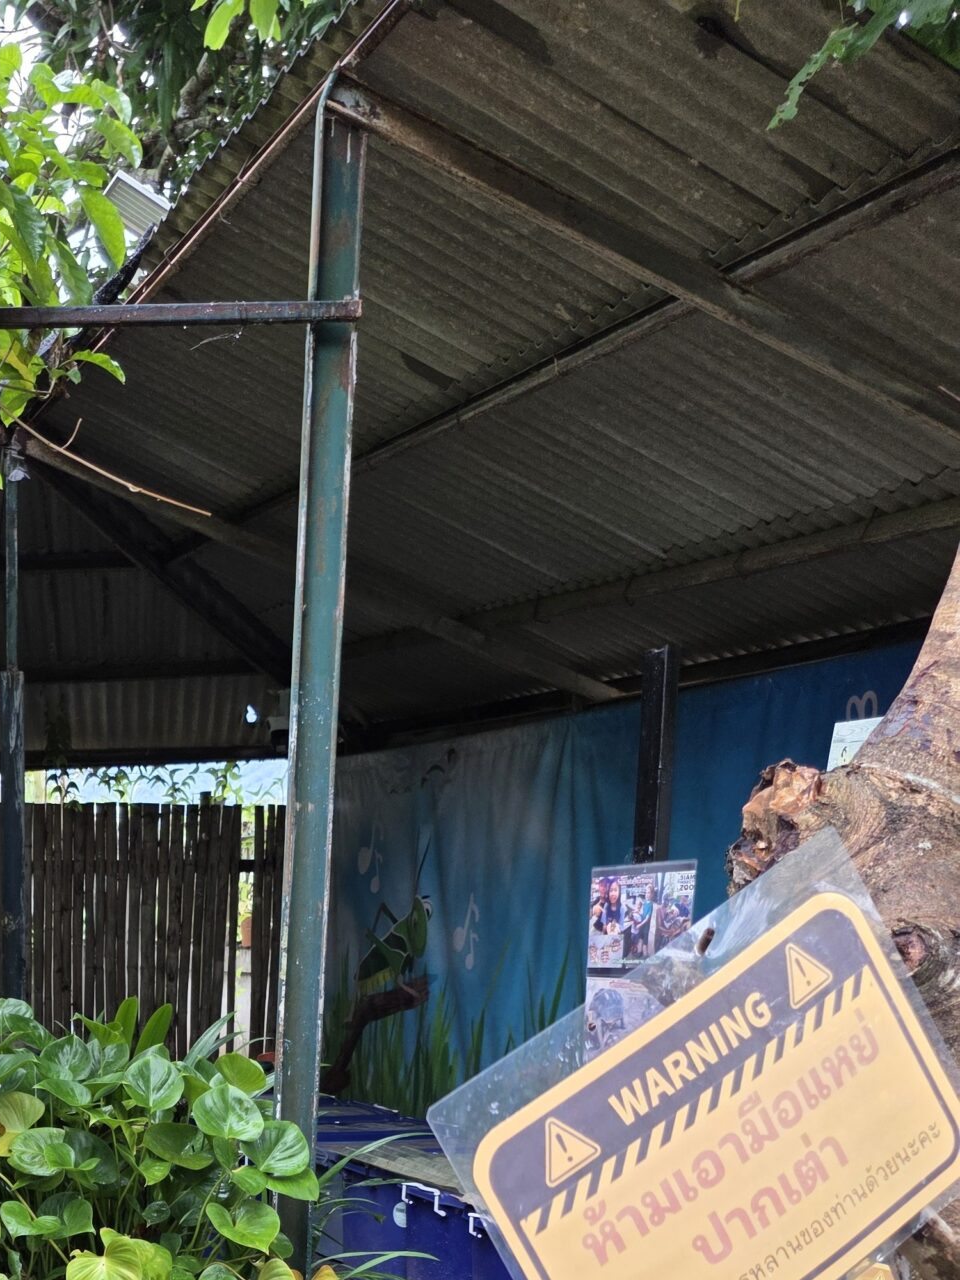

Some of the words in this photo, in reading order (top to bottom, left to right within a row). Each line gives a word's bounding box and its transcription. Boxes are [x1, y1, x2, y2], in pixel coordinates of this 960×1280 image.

[606, 992, 772, 1127] WARNING
[583, 1016, 881, 1266] ห้ามเอามือแหย่
[691, 1131, 849, 1265] ปากเต่า
